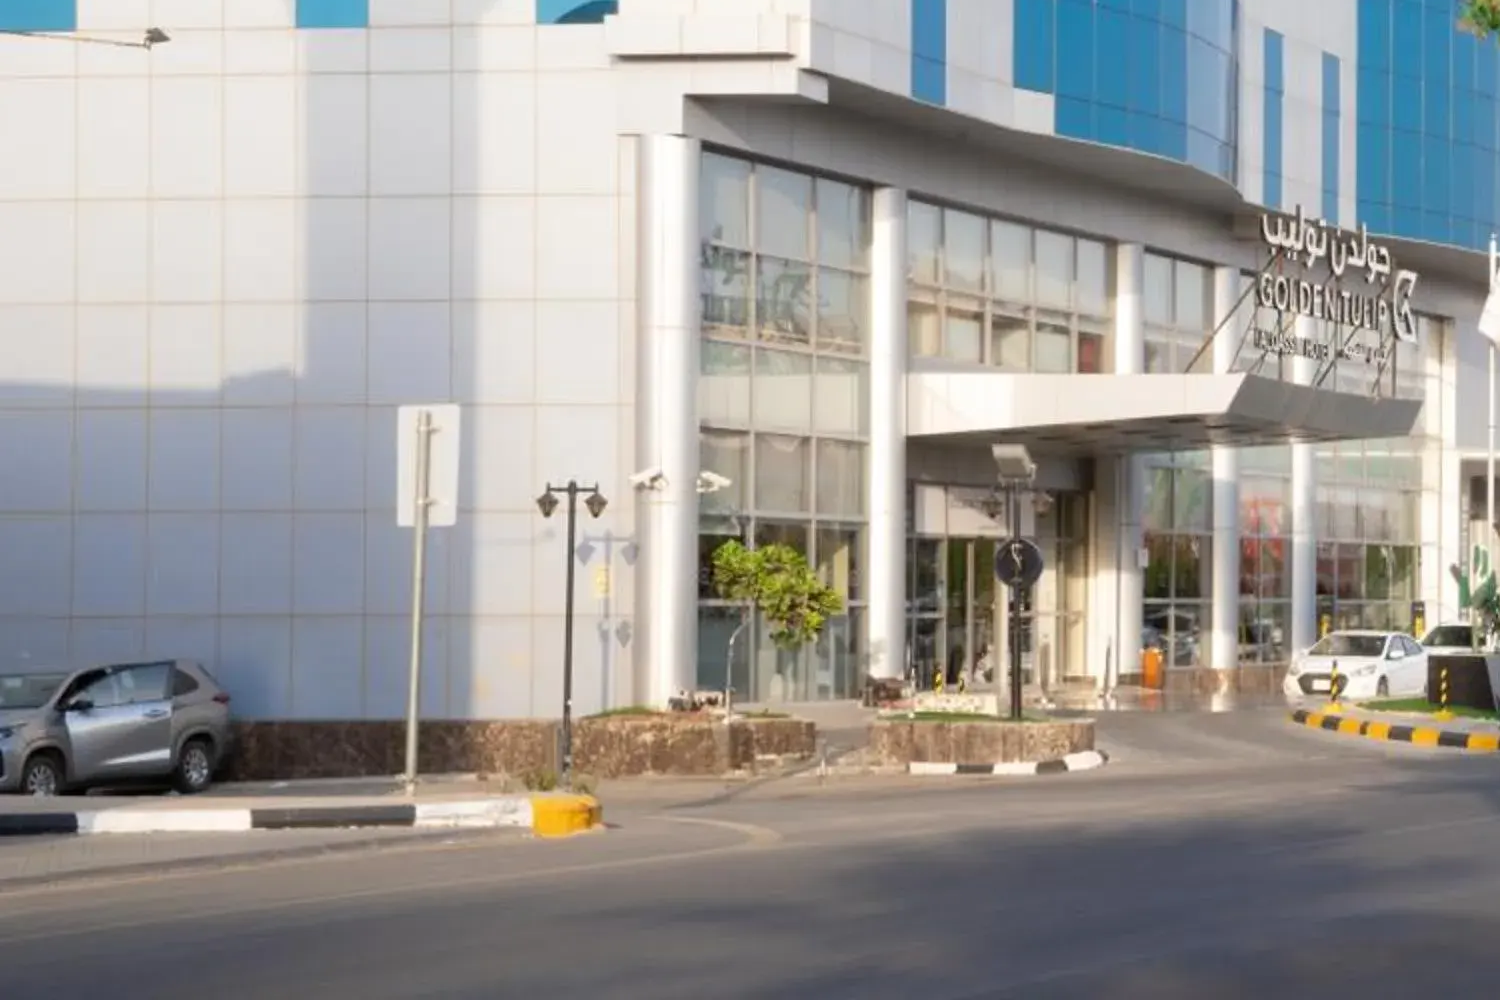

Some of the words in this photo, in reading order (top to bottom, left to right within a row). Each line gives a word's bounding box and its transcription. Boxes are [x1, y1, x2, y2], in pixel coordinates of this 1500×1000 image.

[1262, 205, 1327, 267] توليب
[1331, 223, 1390, 283] جولدن
[1259, 272, 1338, 320] GOLDEN
